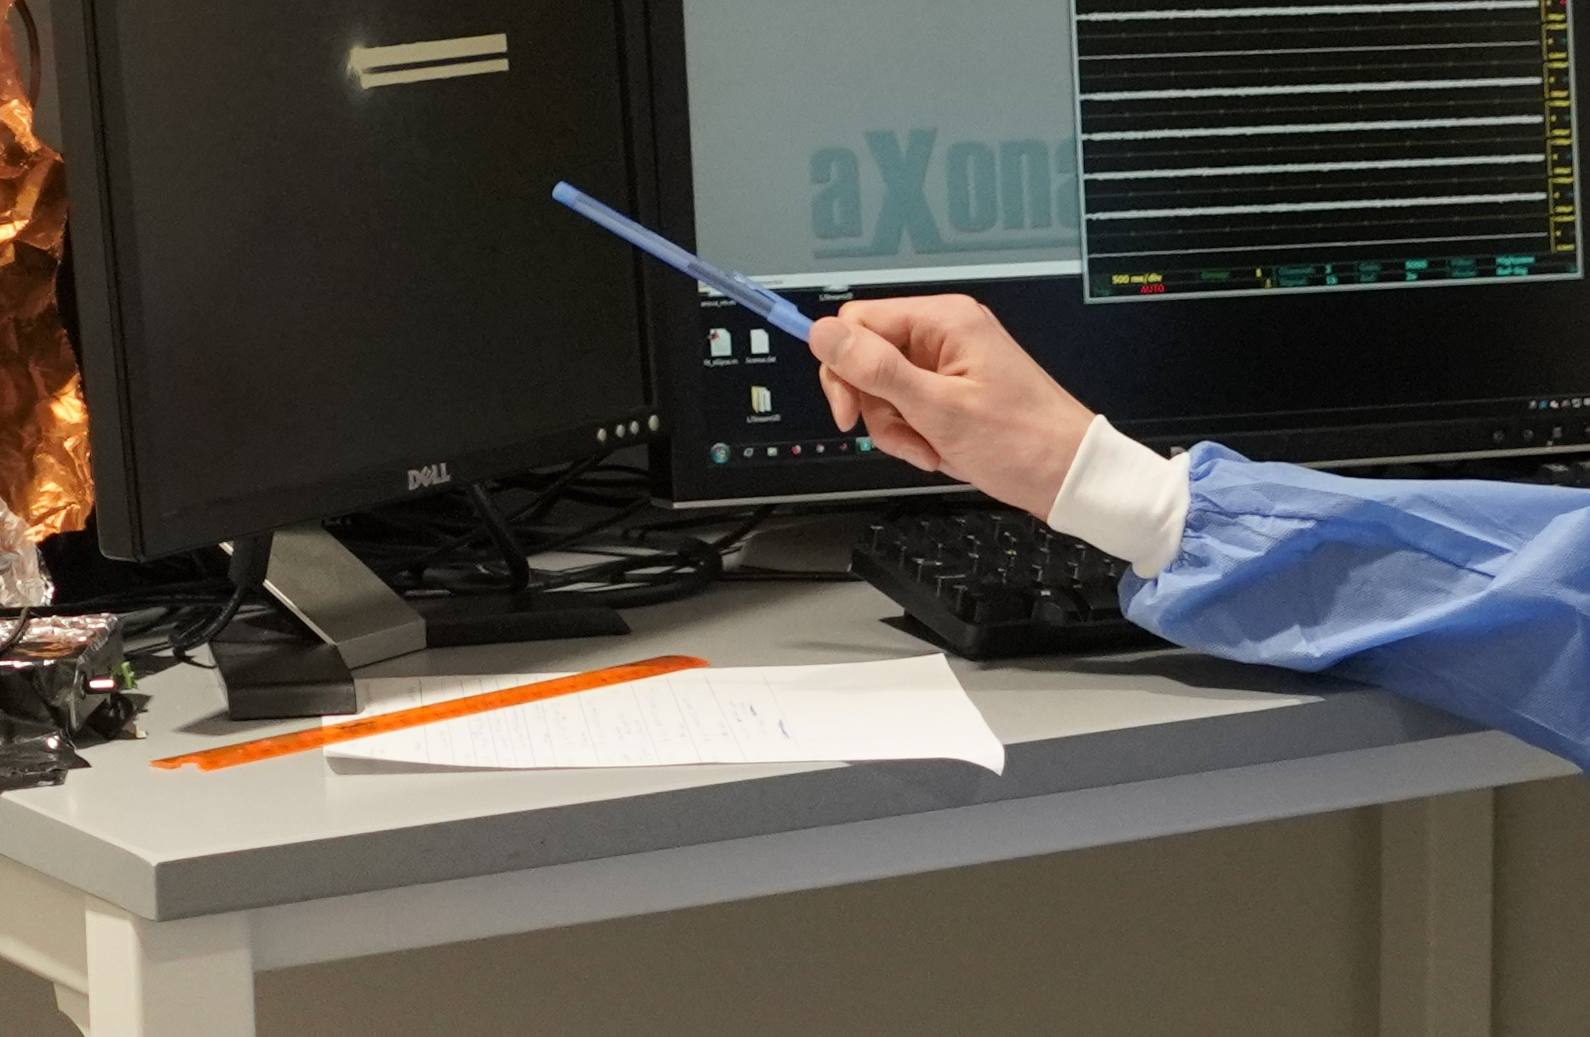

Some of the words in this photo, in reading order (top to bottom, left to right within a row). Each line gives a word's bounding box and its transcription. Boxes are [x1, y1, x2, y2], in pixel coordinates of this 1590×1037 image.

[1112, 275, 1130, 285] 500
[1140, 283, 1166, 294] AUTO
[407, 463, 450, 491] DELL
